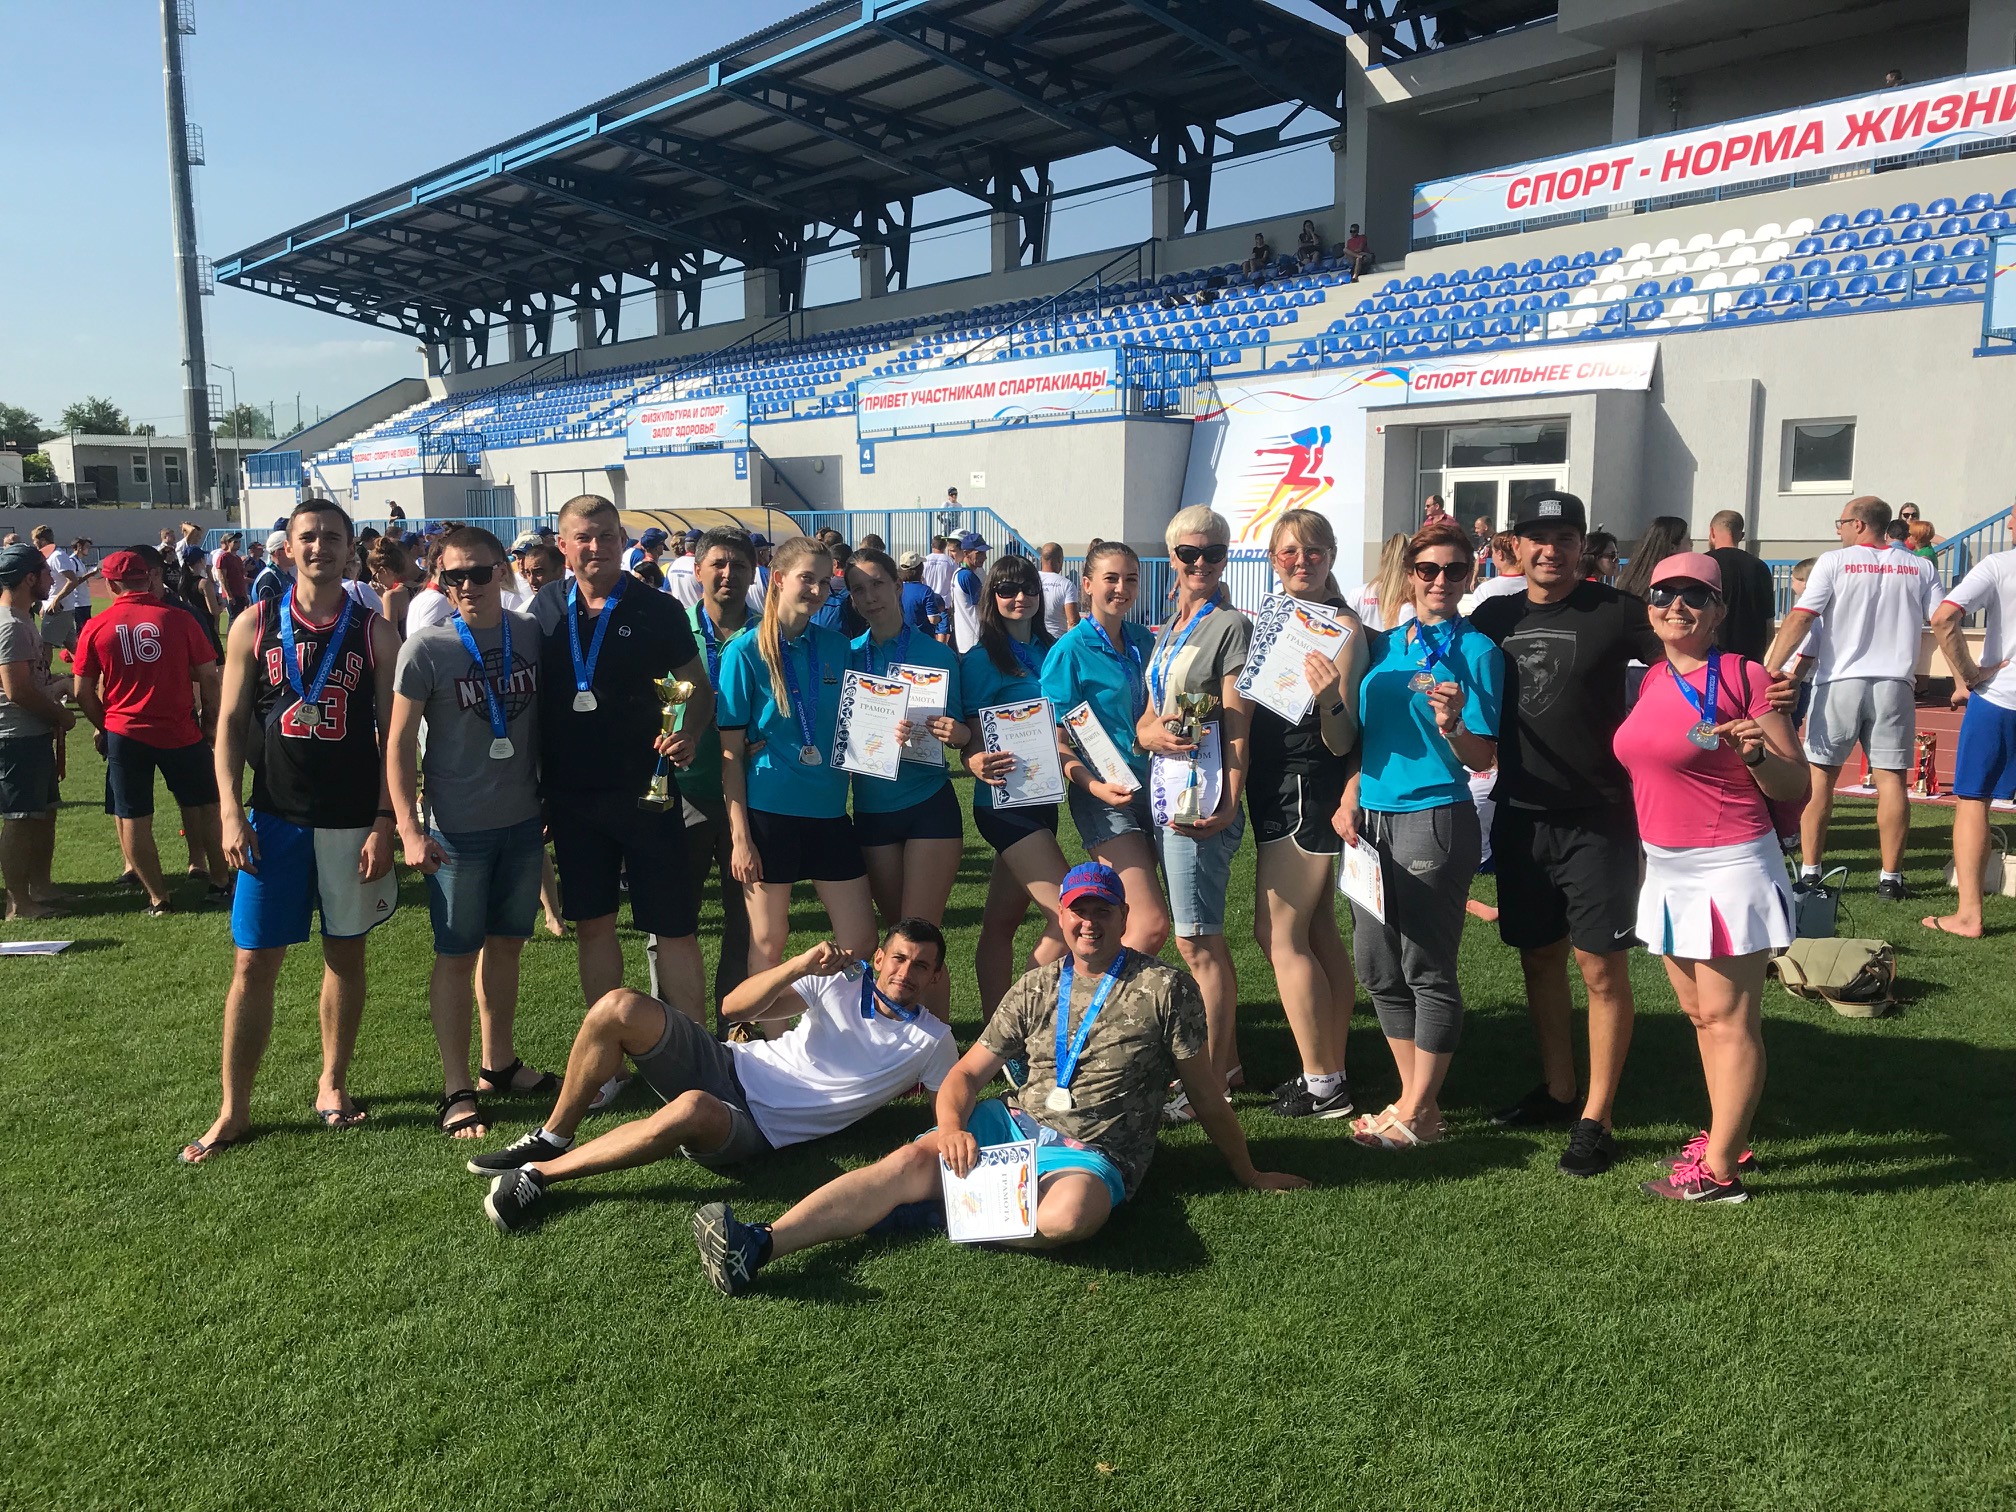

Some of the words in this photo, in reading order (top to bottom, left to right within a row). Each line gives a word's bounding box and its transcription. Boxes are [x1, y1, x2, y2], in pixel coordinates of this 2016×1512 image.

[1507, 157, 1633, 210] СПОРТ
[1661, 121, 1825, 183] НОРМА
[1414, 370, 1477, 391] СПОРТ
[1480, 363, 1573, 388] СИЛЬНЕЕ
[864, 391, 908, 411] ПРИВЕТ
[910, 381, 996, 406] УЧАСТНИКАМ
[998, 369, 1107, 397] СПАРТАКИАДЫ
[641, 408, 692, 423] ФИЗКУЛЬТУРА
[692, 408, 699, 418] И
[700, 404, 725, 418] СПОРТ
[652, 426, 675, 439] ЗАЛОГ
[864, 450, 870, 460] 4
[738, 458, 744, 468] 5
[1845, 564, 1919, 576] РОСТОВ-НА-ДОНУ
[115, 622, 162, 666] 16
[1286, 632, 1312, 652] ГРАМО
[909, 696, 936, 704] АМОТА
[1522, 694, 1530, 704] S
[860, 703, 896, 716] ГРАМОТА
[1004, 729, 1042, 740] ГРАМОТА
[1411, 860, 1434, 870] NIKE
